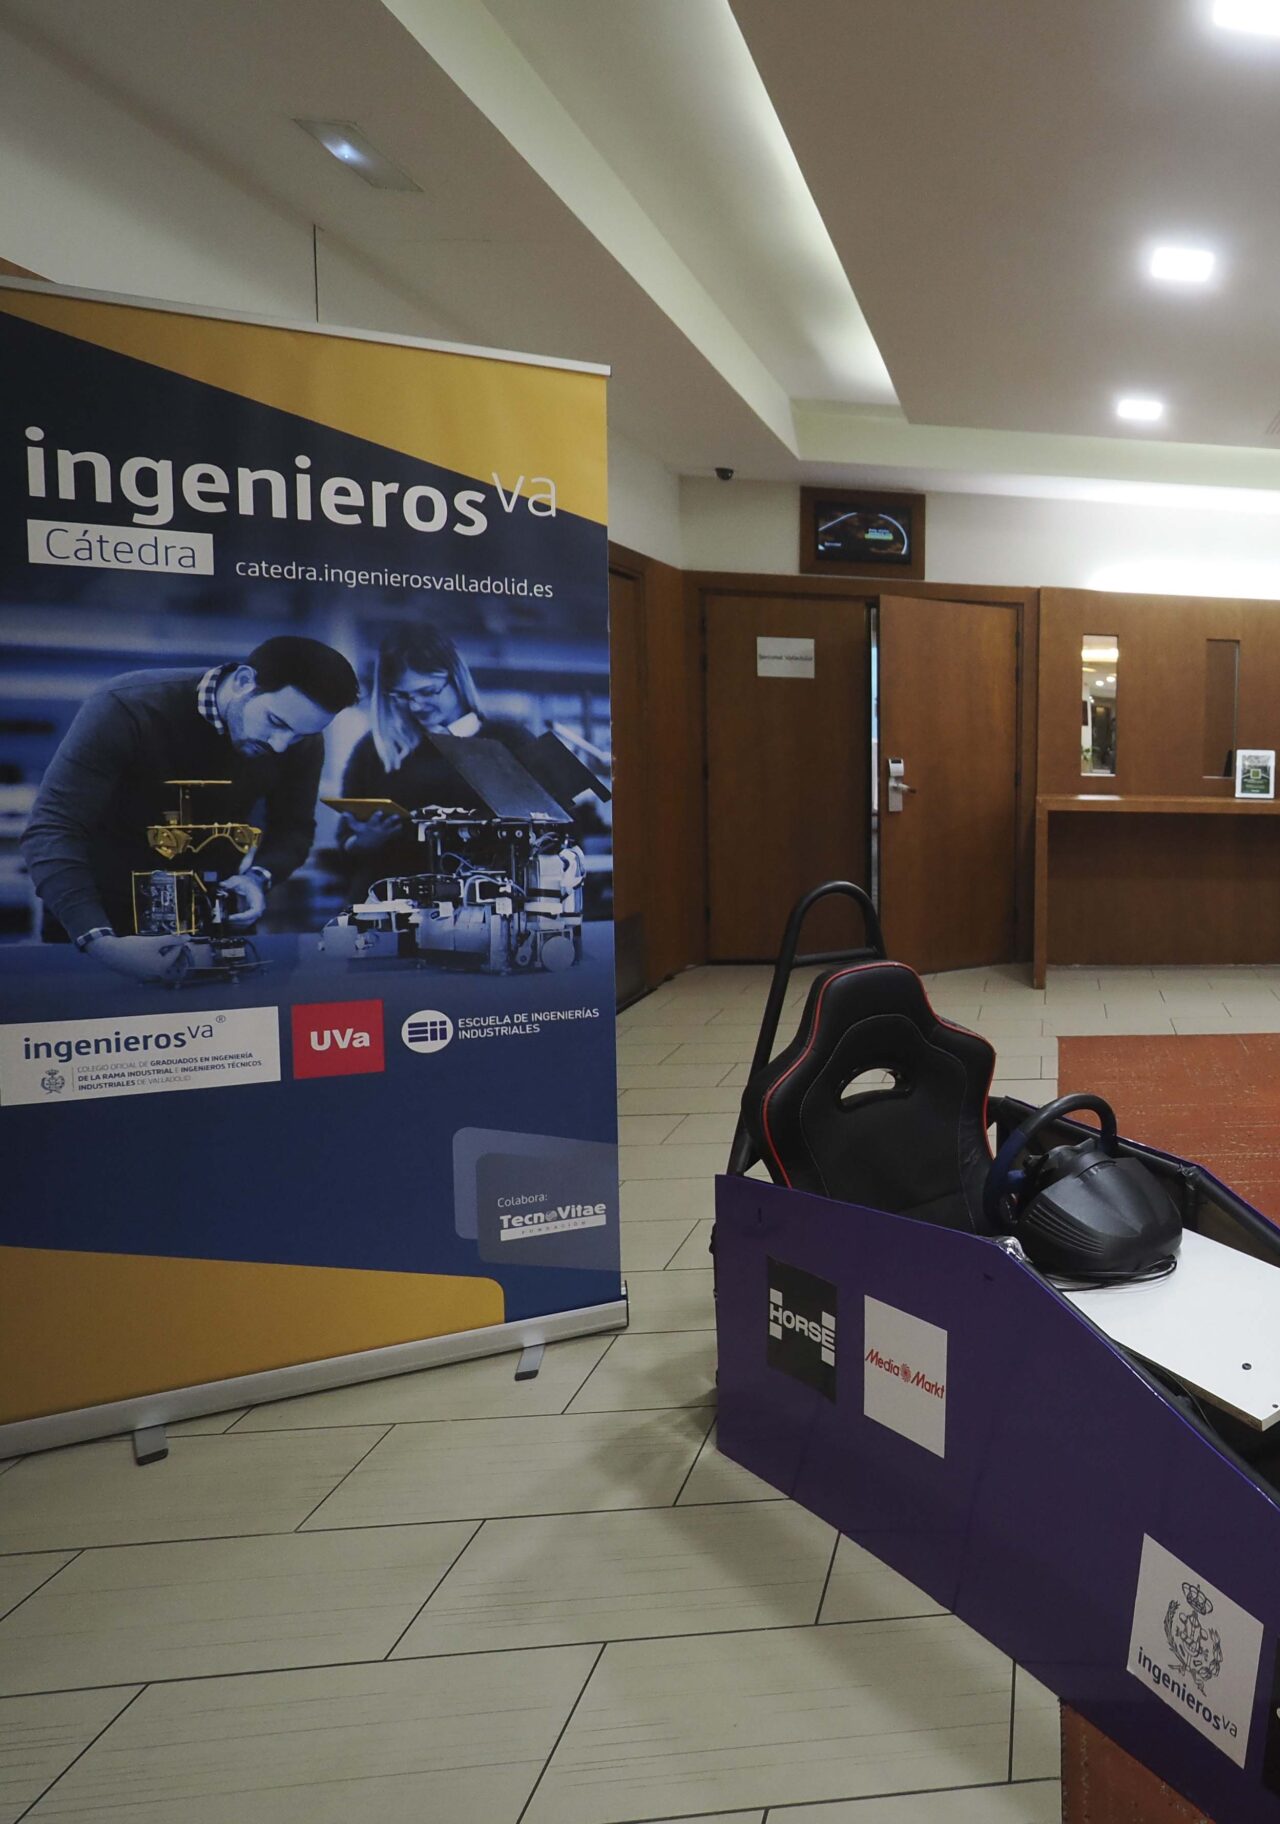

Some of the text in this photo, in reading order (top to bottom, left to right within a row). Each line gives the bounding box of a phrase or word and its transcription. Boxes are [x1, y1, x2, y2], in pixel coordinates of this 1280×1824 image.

[45, 527, 197, 569] Cátedra
[235, 558, 554, 599] catedra.ingenierosvalladolid.es
[458, 1007, 600, 1028] ESCUELA DE INGENIERÍAS
[310, 1028, 370, 1051] UVa
[458, 1023, 541, 1039] INDUSTRIALES
[102, 1071, 126, 1080] RAMA
[127, 1067, 173, 1078] INDUSTRIAL
[180, 1063, 226, 1073] INGENIEROS
[227, 1059, 262, 1069] TÉCNICOS
[150, 1057, 198, 1067] GRADUADOS
[211, 1051, 254, 1062] INGENIERÍA
[78, 1079, 136, 1091] INDUSTRIALES
[497, 1193, 548, 1208] Colabora:
[769, 1302, 836, 1350] HORSE
[864, 1348, 945, 1399] Media Markt
